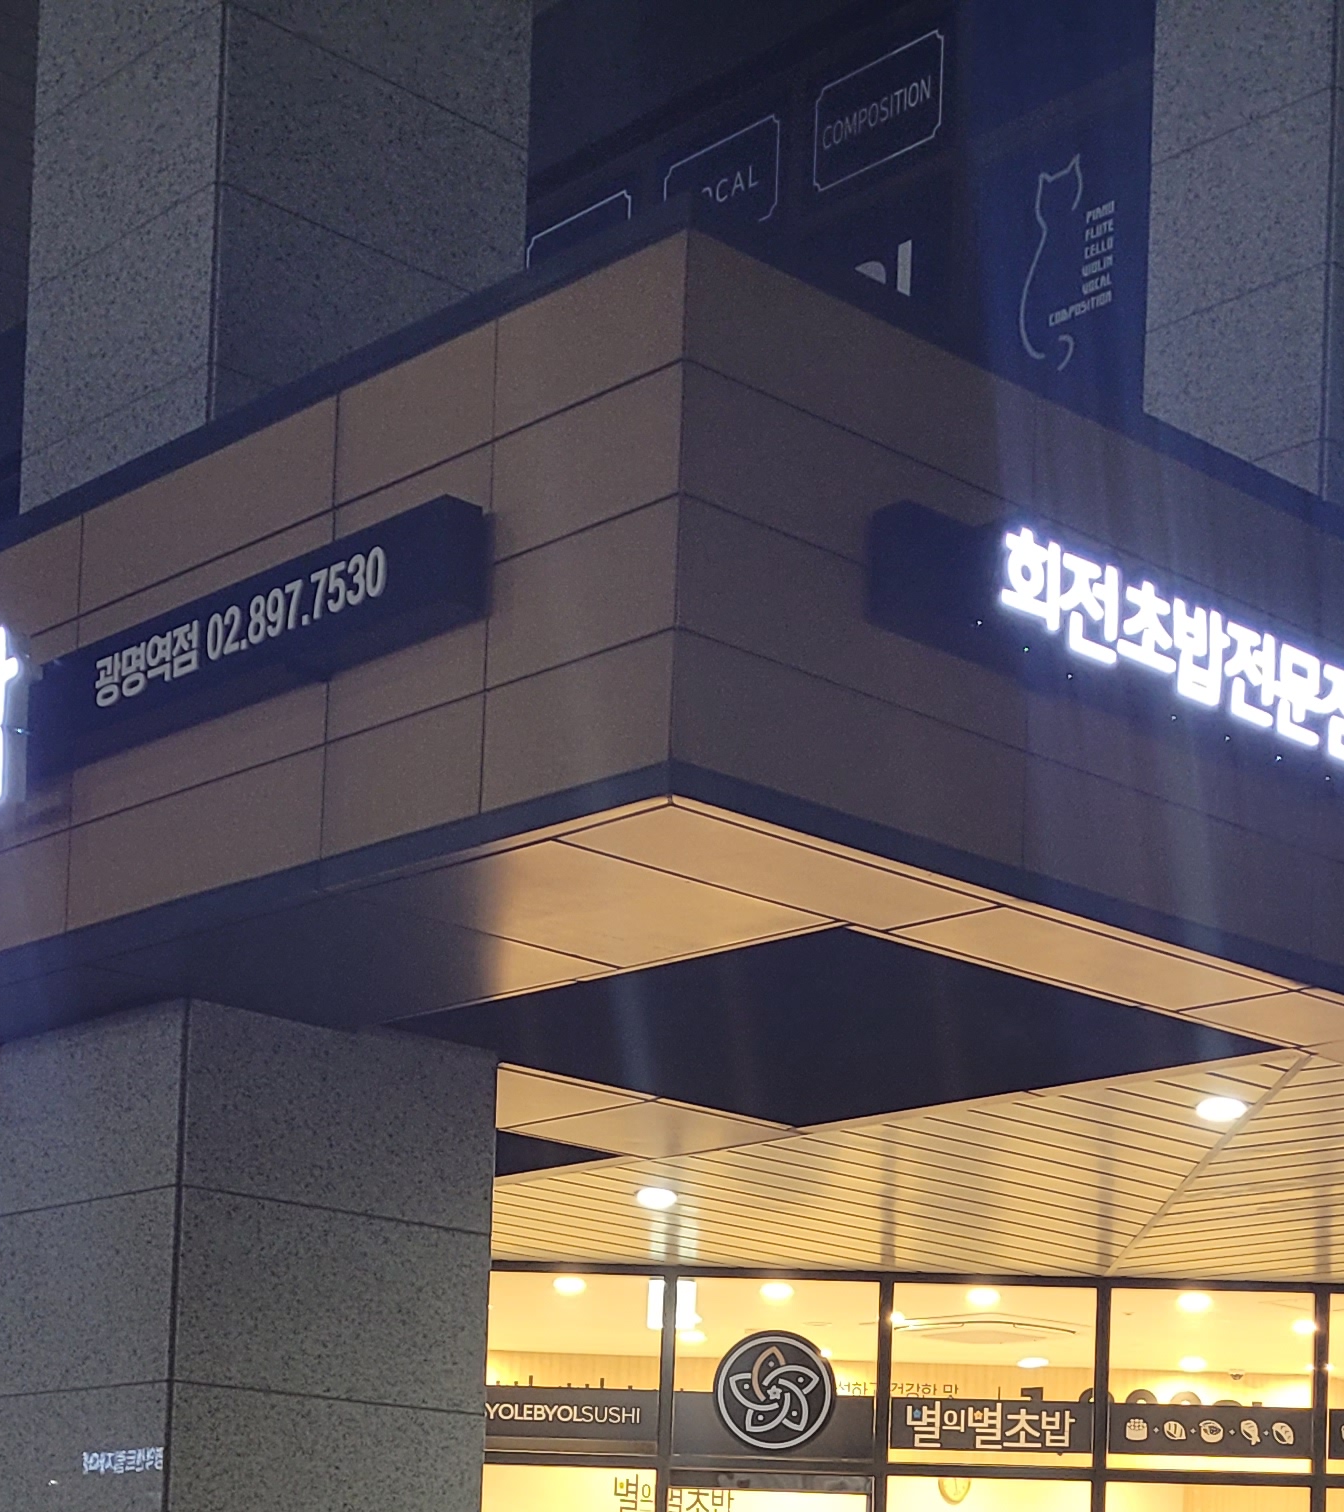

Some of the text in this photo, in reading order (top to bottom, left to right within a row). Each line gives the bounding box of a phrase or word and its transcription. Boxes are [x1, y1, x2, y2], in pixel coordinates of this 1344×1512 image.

[822, 75, 933, 150] COMPOSITION
[702, 165, 759, 203] CAL
[1084, 218, 1114, 242] FLUTE
[1084, 236, 1114, 260] CELLO
[94, 545, 386, 708] 광명역점 02.897.7530
[484, 1403, 641, 1425] YOLEBYOLSUSHI
[906, 1400, 1076, 1450] 별의별초밥
